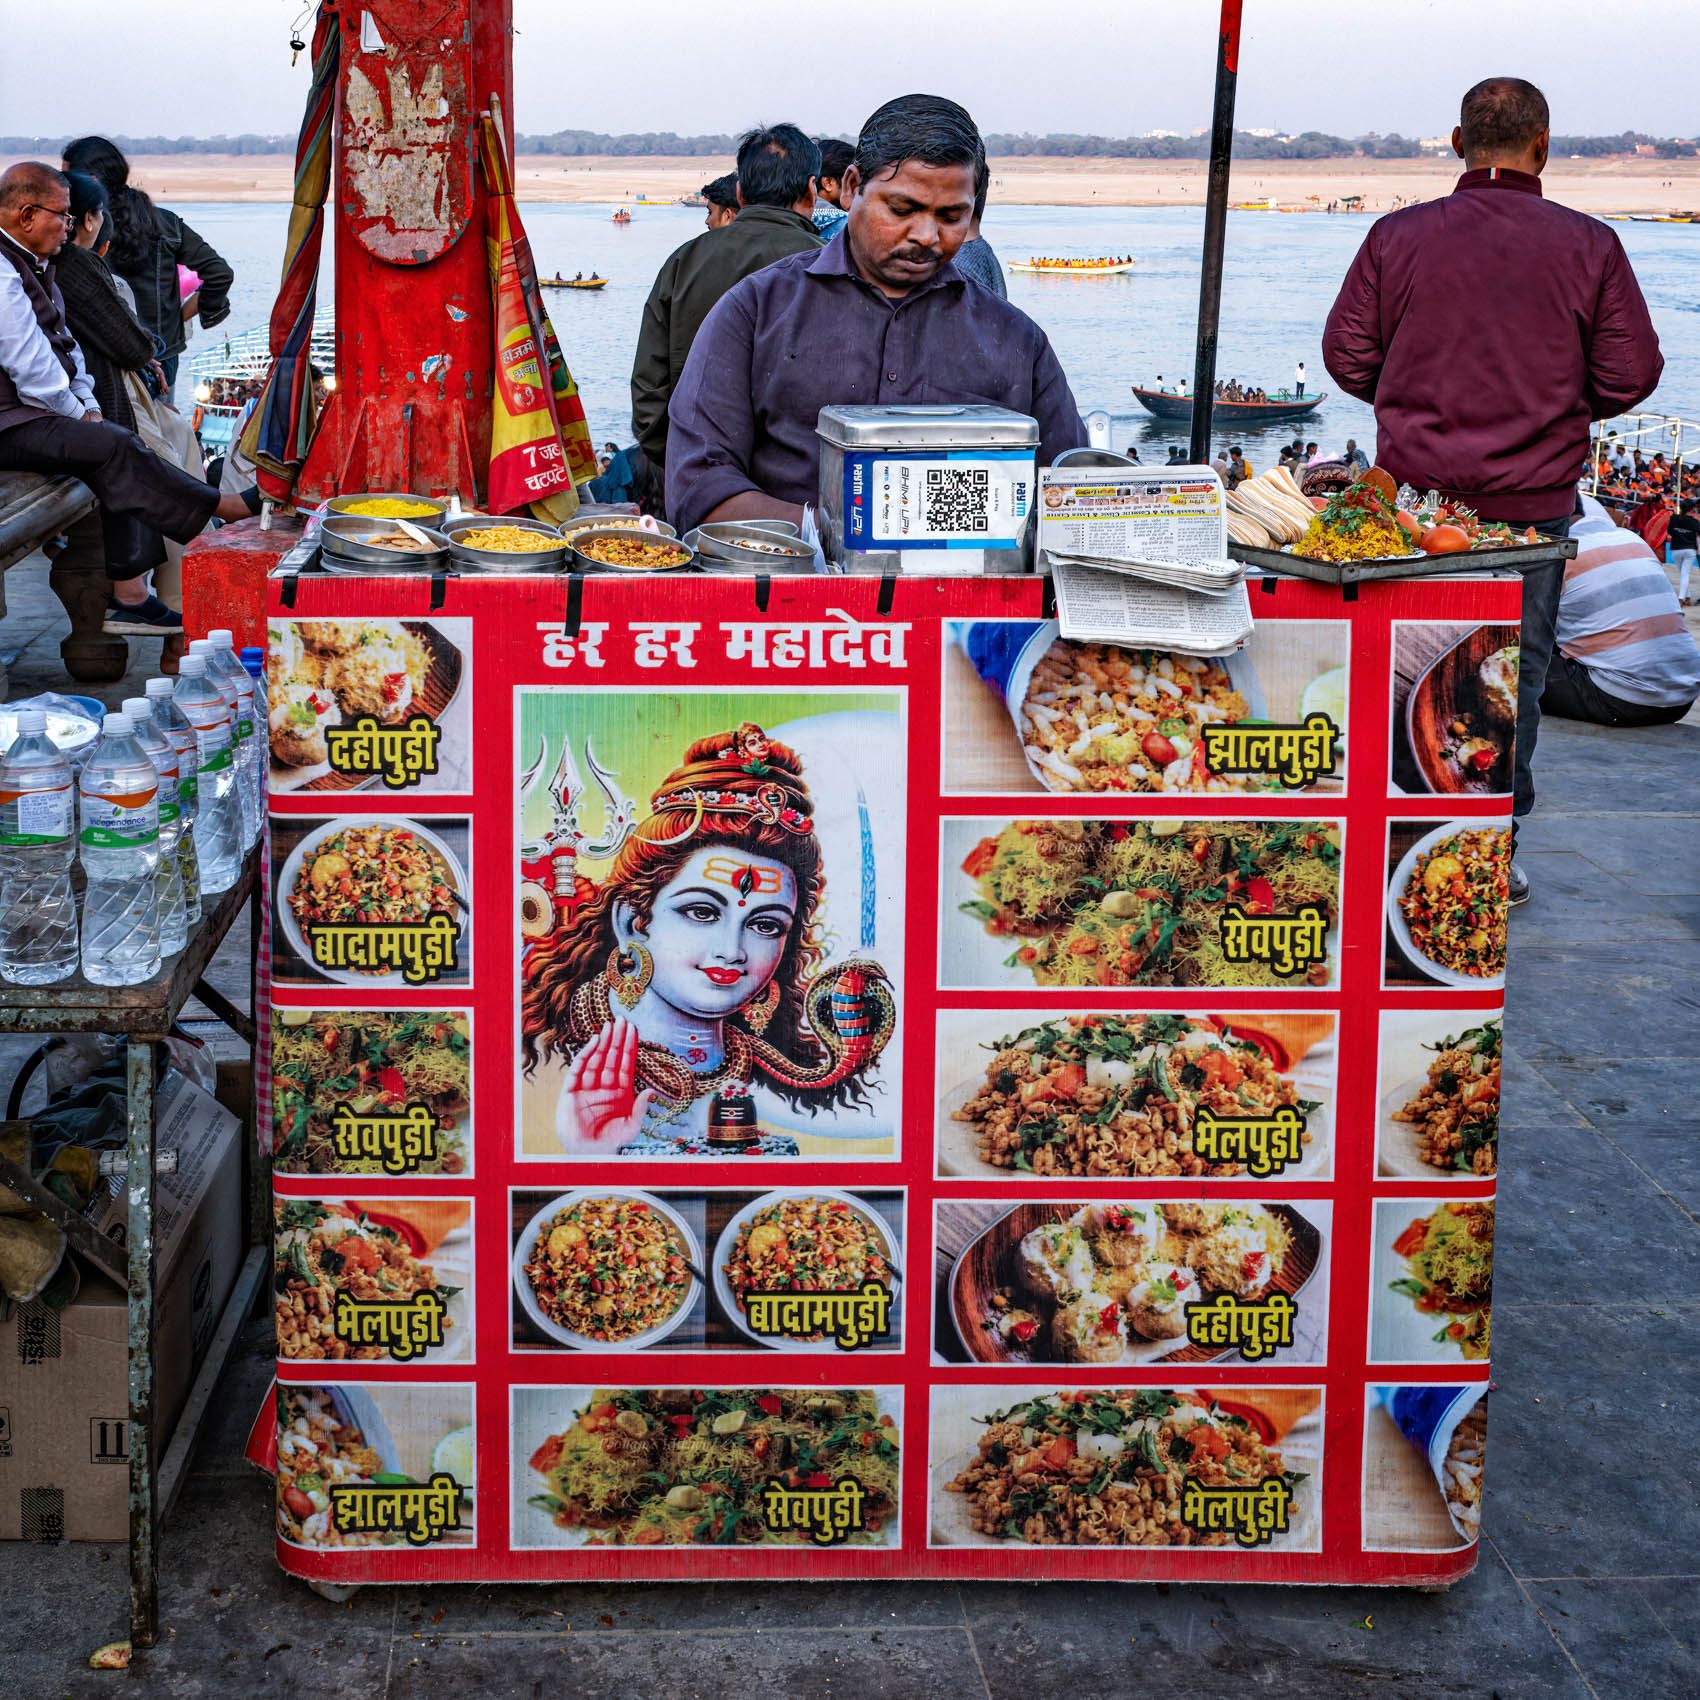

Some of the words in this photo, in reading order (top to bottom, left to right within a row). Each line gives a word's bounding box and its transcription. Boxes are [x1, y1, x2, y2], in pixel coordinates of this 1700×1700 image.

[522, 446, 536, 468] 7
[901, 466, 910, 501] BHIM
[853, 506, 863, 532] UPI
[901, 509, 910, 532] UPI
[536, 622, 610, 668] हर
[628, 622, 702, 668] हर
[719, 608, 913, 668] महादेव
[328, 719, 438, 785] दहीपुड़ी
[1206, 718, 1336, 785] झालमुड़ी
[312, 916, 457, 981] बादामपुड़ी
[1225, 908, 1327, 974] सेवपुड़ी
[333, 1106, 436, 1171] सेवपुड़ी
[1196, 1109, 1303, 1174] भेलपुड़ी
[338, 1293, 443, 1357] भेलपुड़ी
[746, 1285, 889, 1347] बादामपुड़ी
[1188, 1296, 1295, 1358] दहीपुड़ी
[333, 1477, 459, 1541] झालमुड़ी
[765, 1480, 865, 1542] सेवपुड़ी
[1185, 1480, 1289, 1543] भेलपुड़ी
